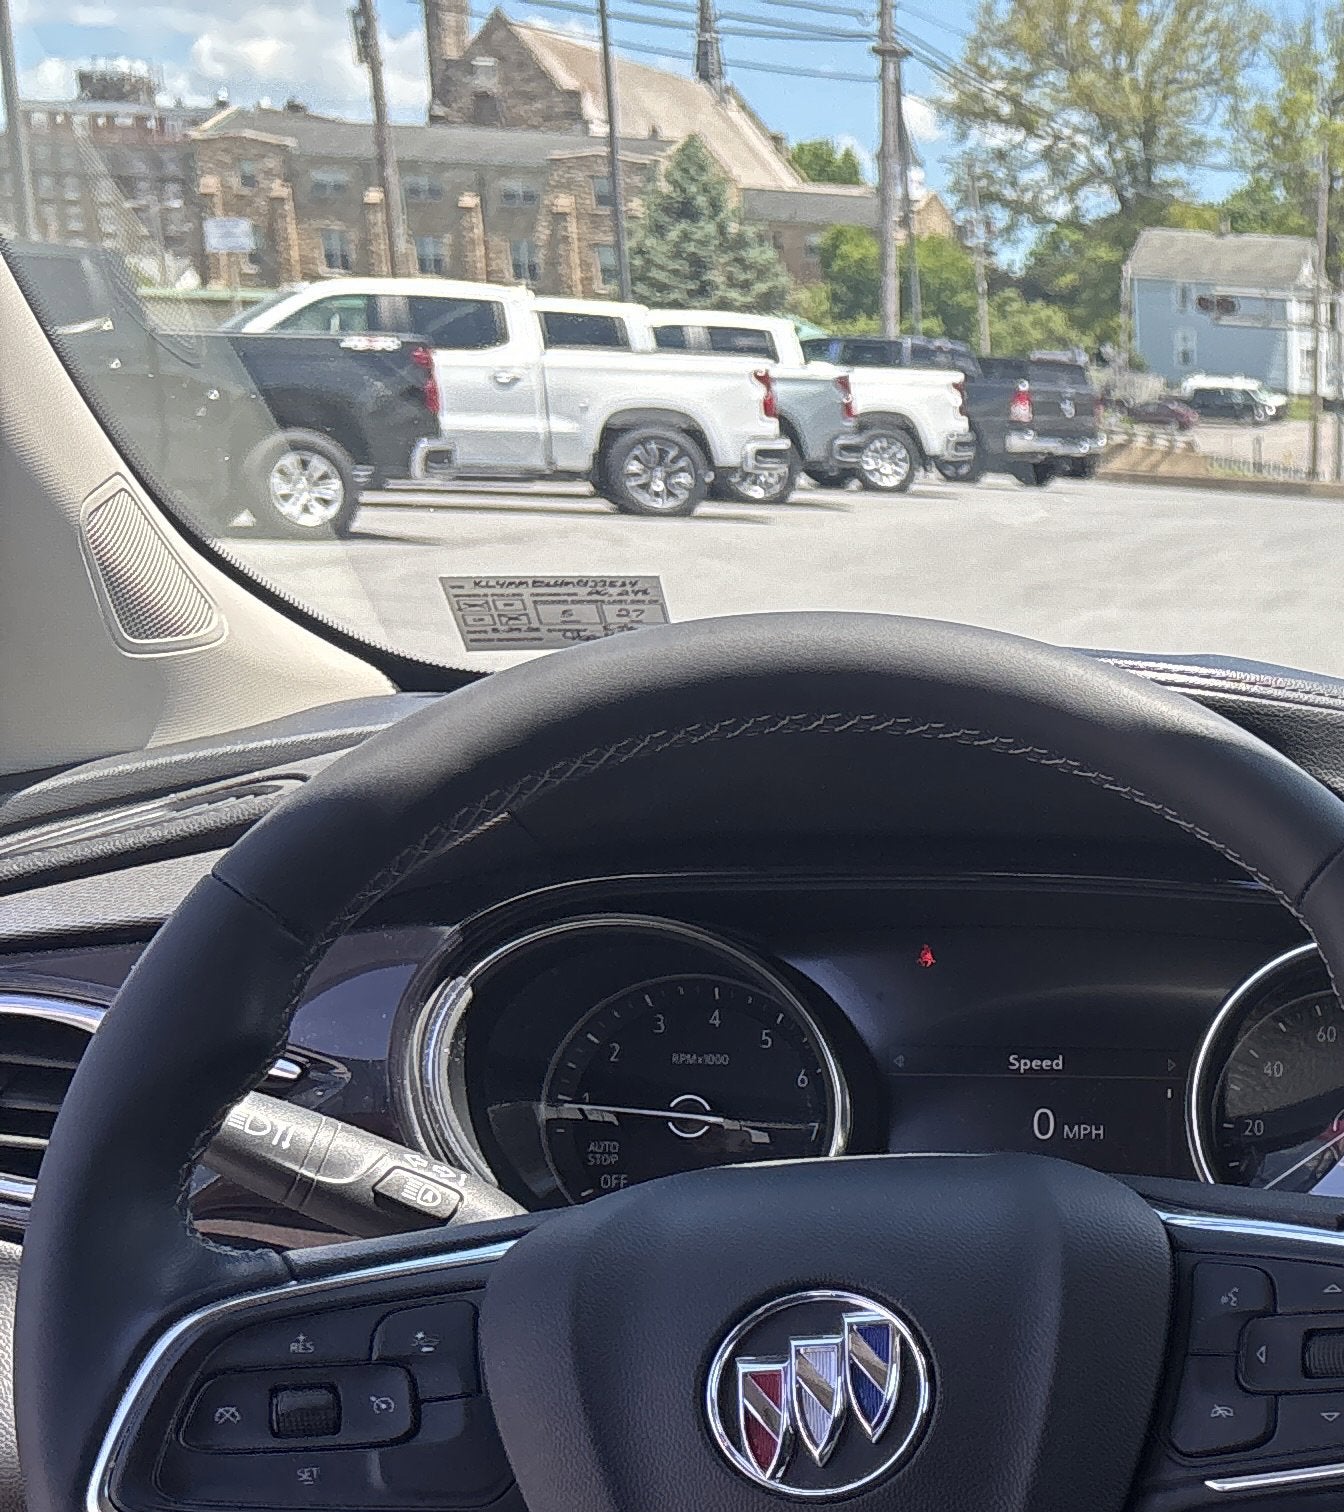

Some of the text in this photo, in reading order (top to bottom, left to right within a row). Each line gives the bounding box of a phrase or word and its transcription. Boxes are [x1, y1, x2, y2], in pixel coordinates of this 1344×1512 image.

[654, 1014, 665, 1033] 3
[709, 1009, 720, 1028] 4
[761, 1030, 772, 1048] 5
[1317, 1026, 1337, 1043] 60
[609, 1043, 620, 1062] 2
[1008, 1055, 1063, 1073] Speed
[1264, 1061, 1283, 1077] 40
[797, 1070, 808, 1088] 6
[1033, 1108, 1104, 1140] 0 MPH
[1244, 1120, 1264, 1136] 20
[588, 1142, 619, 1153] AUTO
[588, 1154, 619, 1166] STOP
[601, 1175, 628, 1188] OFF
[289, 1342, 315, 1354] RES
[297, 1467, 320, 1481] SET
